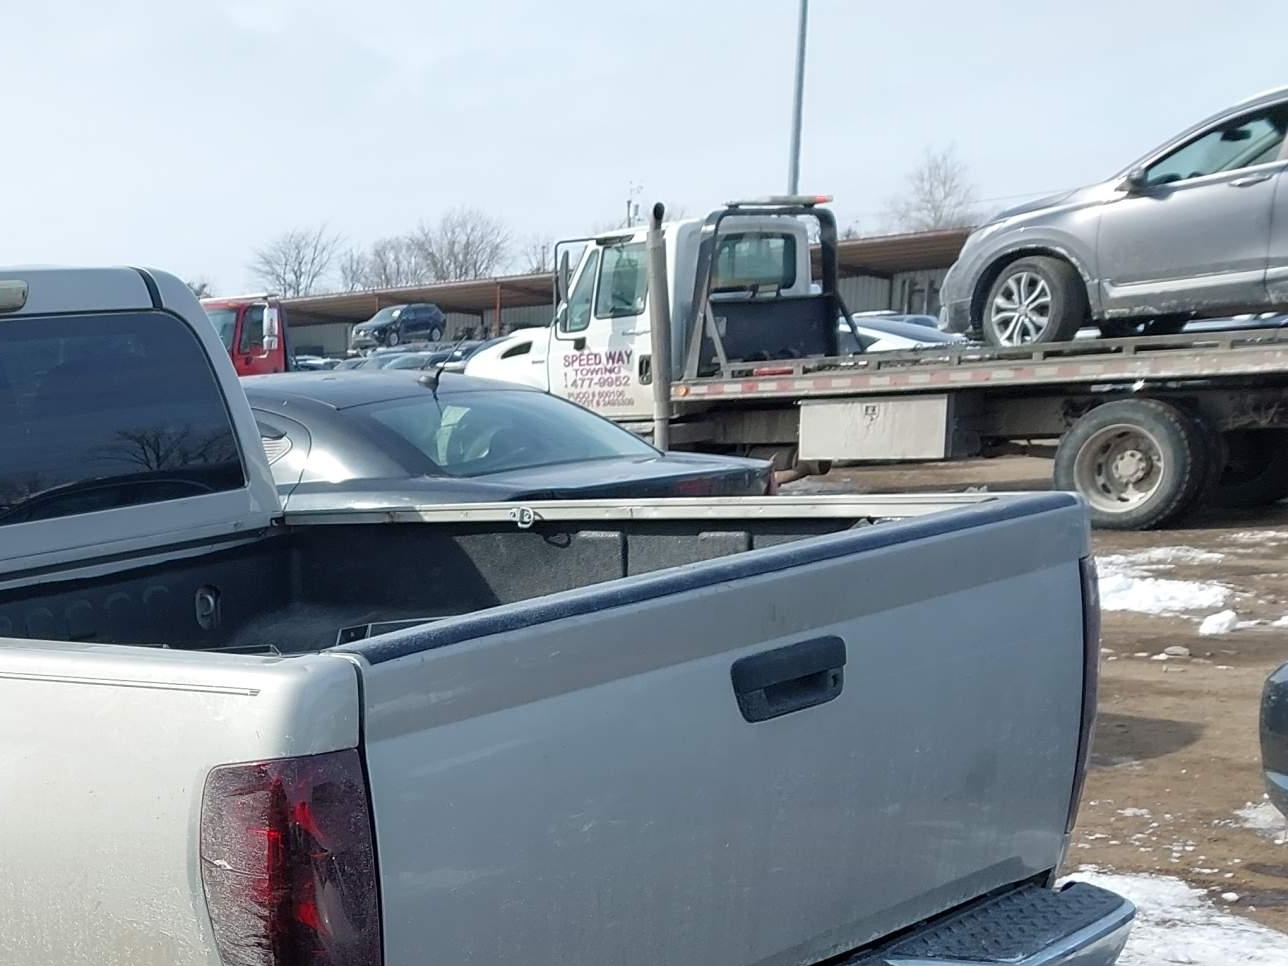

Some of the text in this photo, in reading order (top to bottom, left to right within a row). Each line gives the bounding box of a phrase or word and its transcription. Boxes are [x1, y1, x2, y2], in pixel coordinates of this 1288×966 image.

[563, 350, 632, 368] SPEED WAY
[572, 366, 621, 377] TOWING
